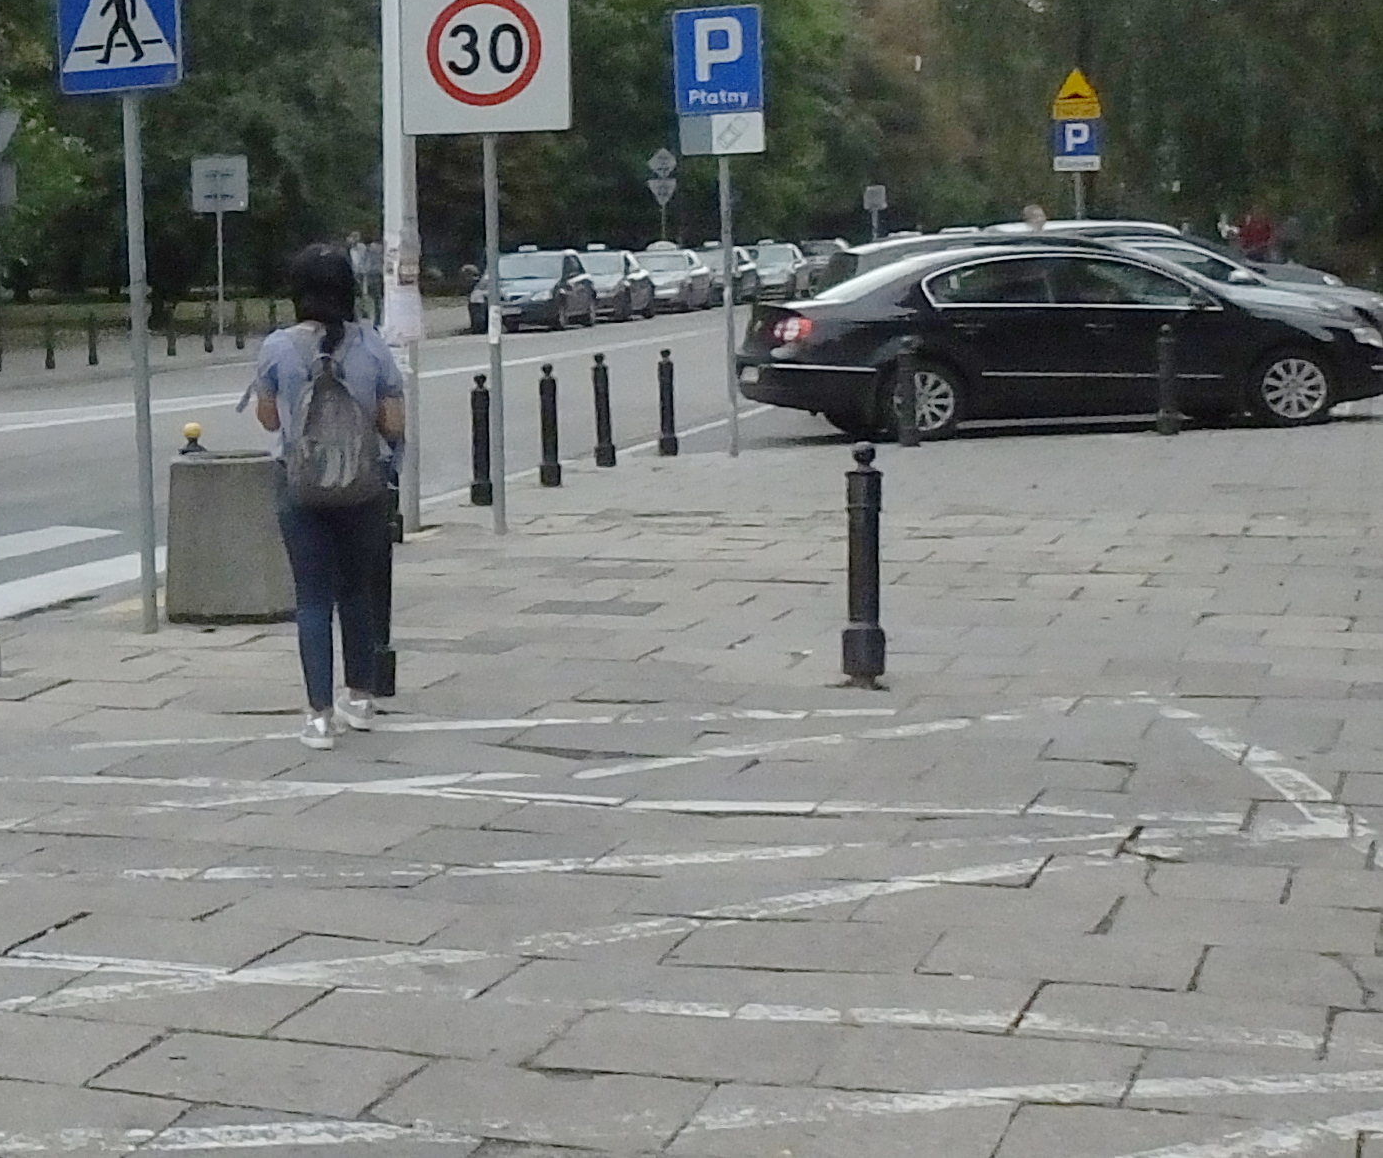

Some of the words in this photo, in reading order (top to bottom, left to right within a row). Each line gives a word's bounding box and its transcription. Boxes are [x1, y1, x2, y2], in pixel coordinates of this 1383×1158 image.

[447, 24, 523, 76] 30
[694, 16, 743, 82] P
[1064, 122, 1091, 153] P
